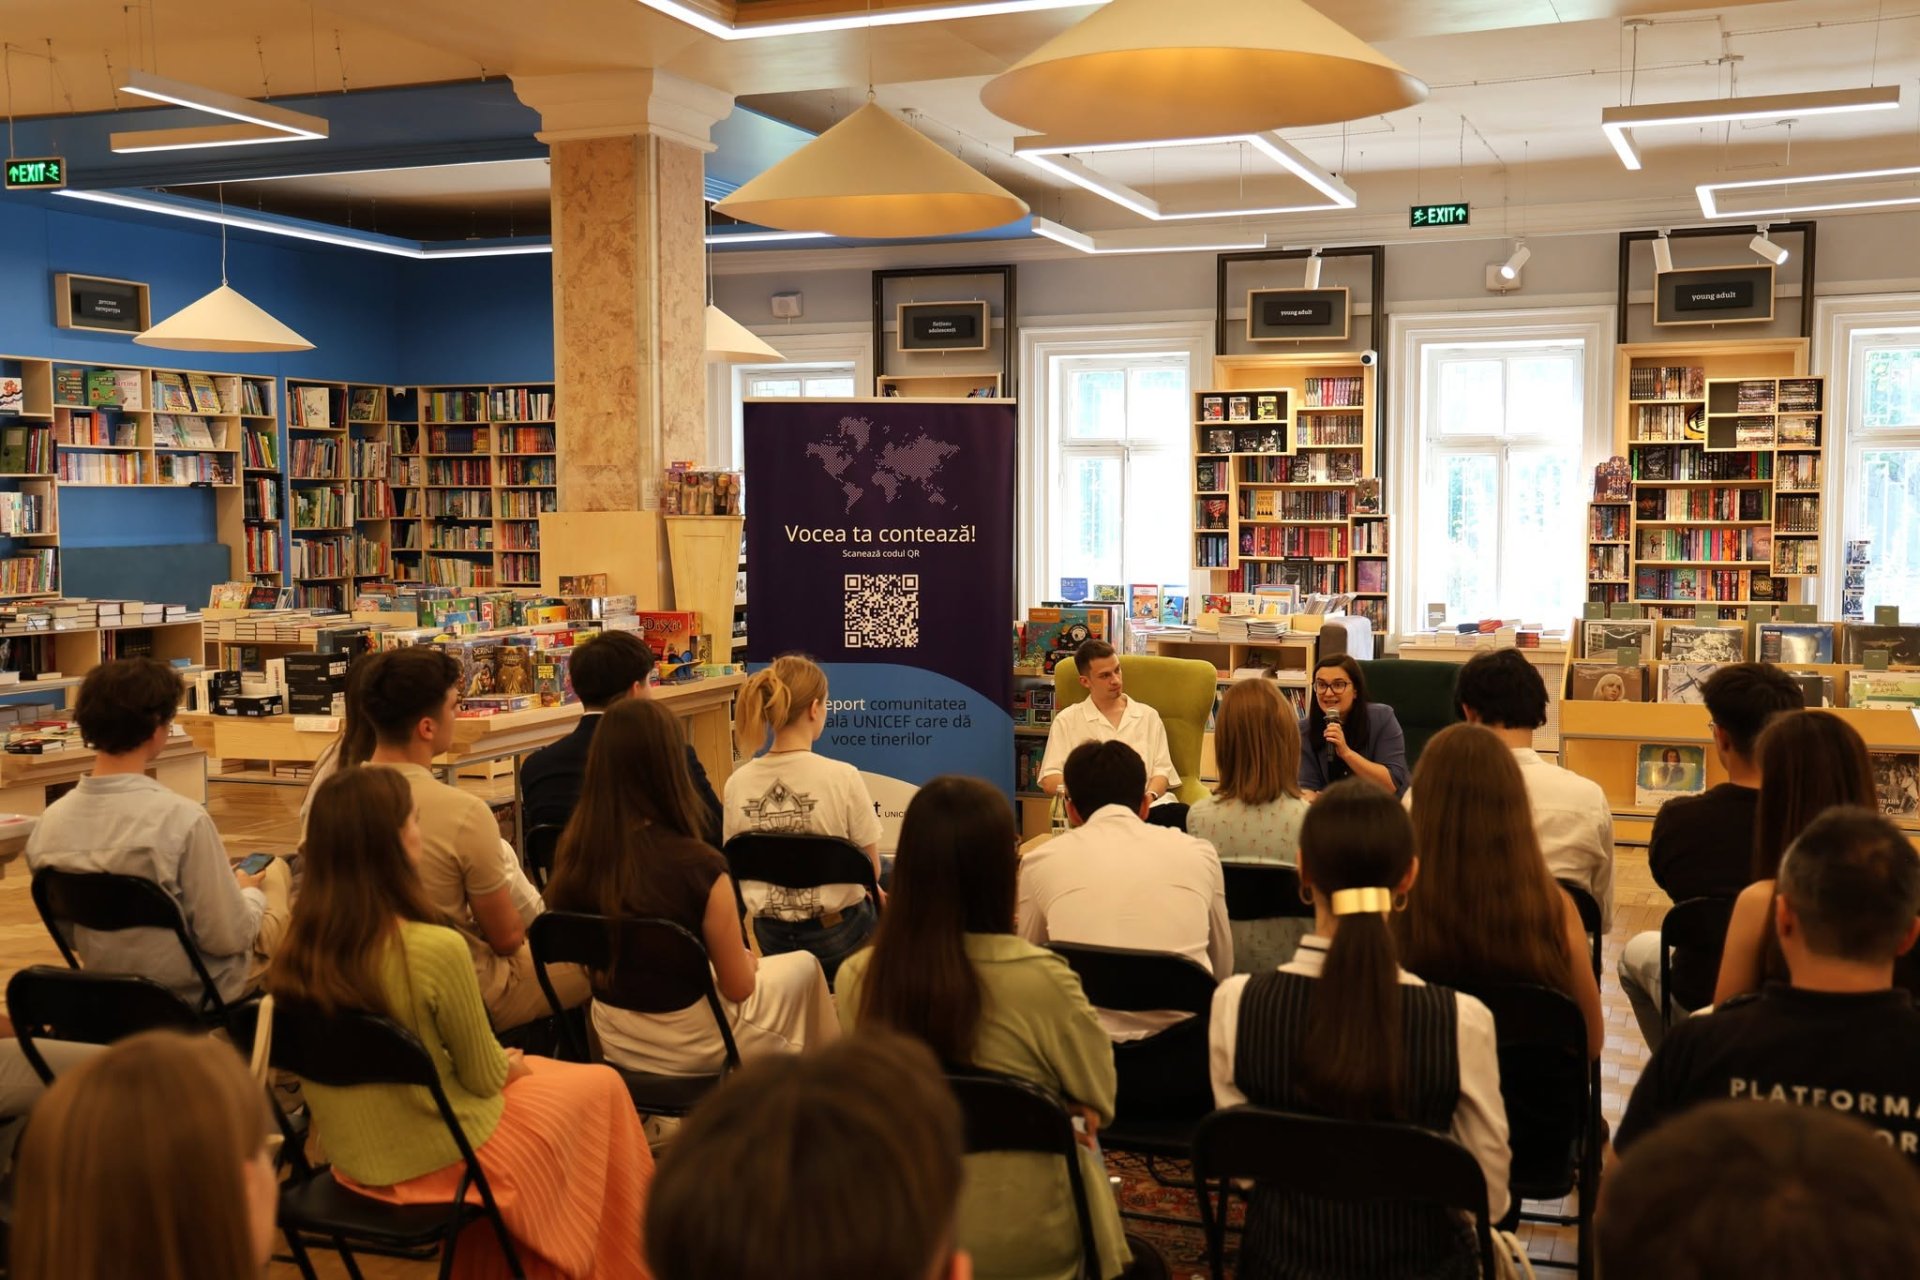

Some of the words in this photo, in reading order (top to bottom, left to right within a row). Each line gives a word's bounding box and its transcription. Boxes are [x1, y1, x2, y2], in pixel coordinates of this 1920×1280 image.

[19, 163, 45, 182] EXIT
[1428, 206, 1456, 224] EXIT
[1691, 293, 1715, 302] young
[1716, 291, 1736, 299] adult
[785, 525, 846, 543] Vocea
[853, 526, 872, 543] ta
[879, 524, 976, 543] contează!
[842, 549, 881, 558] Scanează
[882, 549, 906, 558] codul
[907, 550, 920, 559] QR
[825, 699, 866, 714] eport
[870, 698, 967, 711] comunitatea
[853, 715, 911, 729] UNICEF
[915, 717, 948, 729] care
[952, 714, 972, 729] dă
[831, 734, 867, 746] voce
[871, 732, 933, 746] tinerilor
